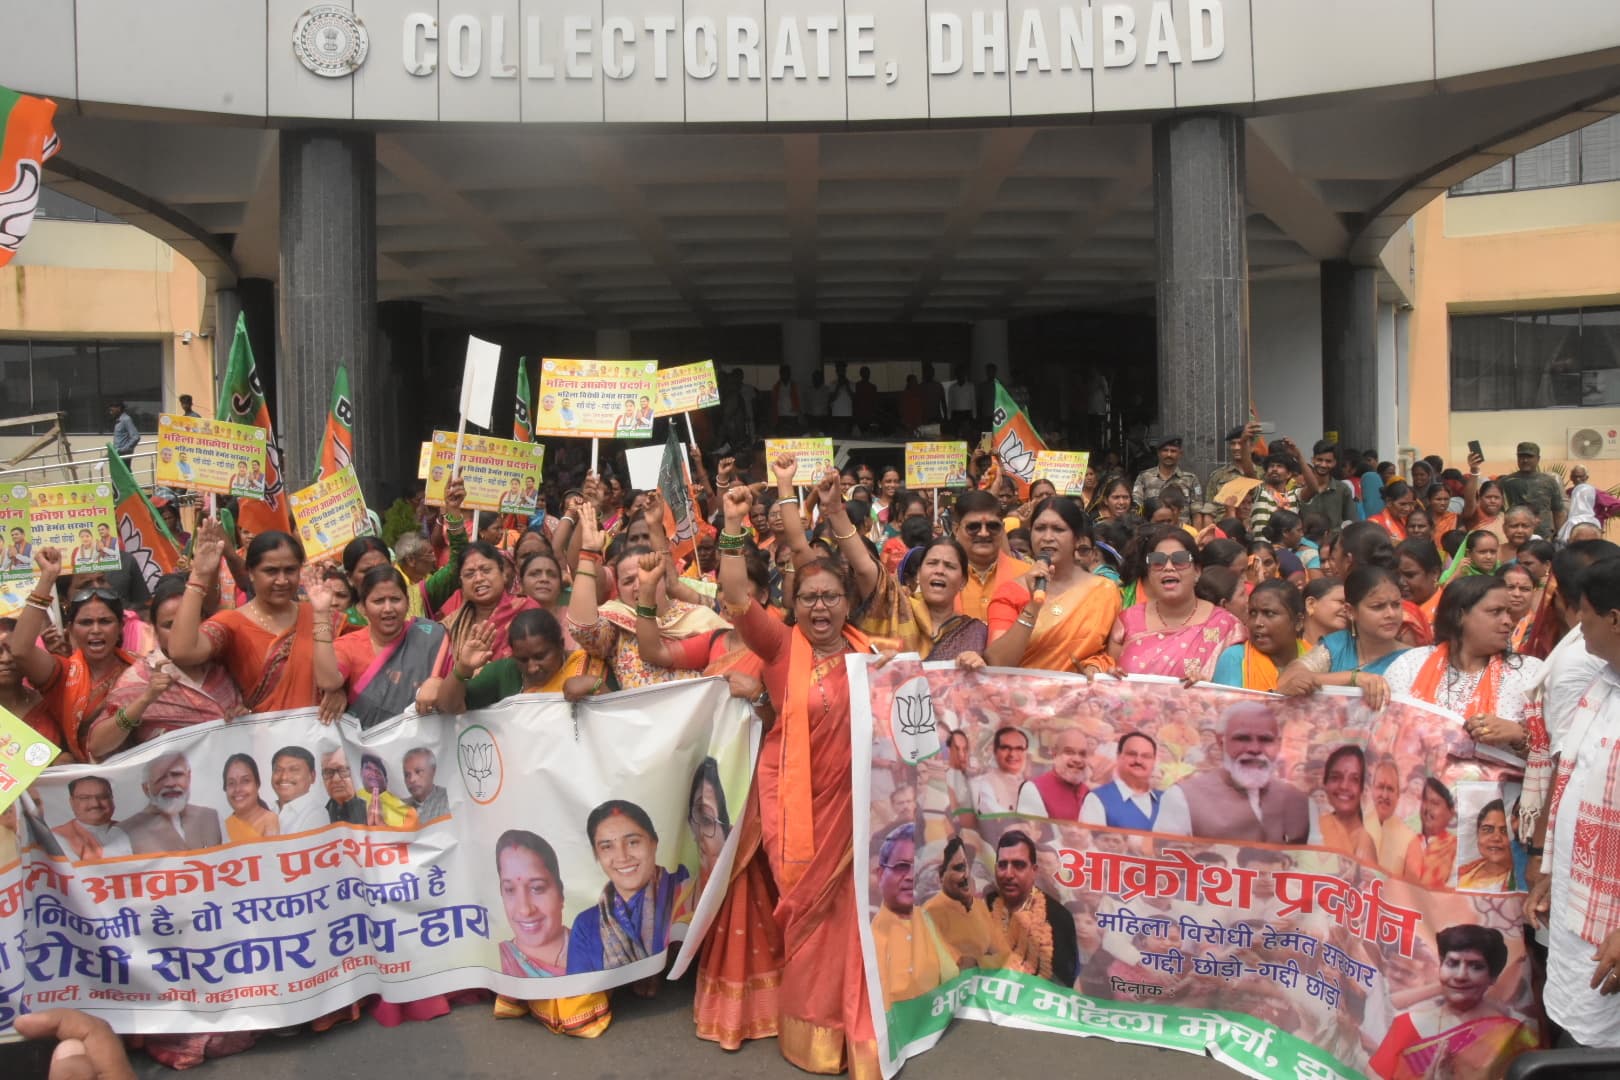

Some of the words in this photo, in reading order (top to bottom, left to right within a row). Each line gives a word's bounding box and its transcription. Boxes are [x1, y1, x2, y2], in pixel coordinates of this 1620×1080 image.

[403, 12, 898, 84] COLLECTORATE,
[930, 0, 1225, 75] DHANBAD
[67, 506, 107, 519] प्रदर्शन
[82, 855, 262, 904] आक्रोश
[277, 835, 411, 883] प्रदर्शन
[35, 894, 141, 940] निकम्मी
[192, 901, 223, 932] वो
[232, 885, 330, 924] सरकार
[427, 865, 447, 897] है
[1053, 848, 1257, 909] आक्रोश
[1272, 872, 1423, 958] प्रदर्शन
[149, 929, 317, 983] सरकार
[1096, 908, 1170, 938] महिला
[1180, 915, 1253, 948] विरोधी
[1262, 924, 1317, 957] हेमंत
[1323, 942, 1377, 988] सरकार
[88, 988, 151, 1002] महिला
[288, 965, 340, 993] धनबाद
[1111, 976, 1163, 995] दिनांक
[1140, 949, 1184, 974] गद्दी
[1305, 971, 1341, 1010] छोड़ो
[1033, 991, 1168, 1035] महिला
